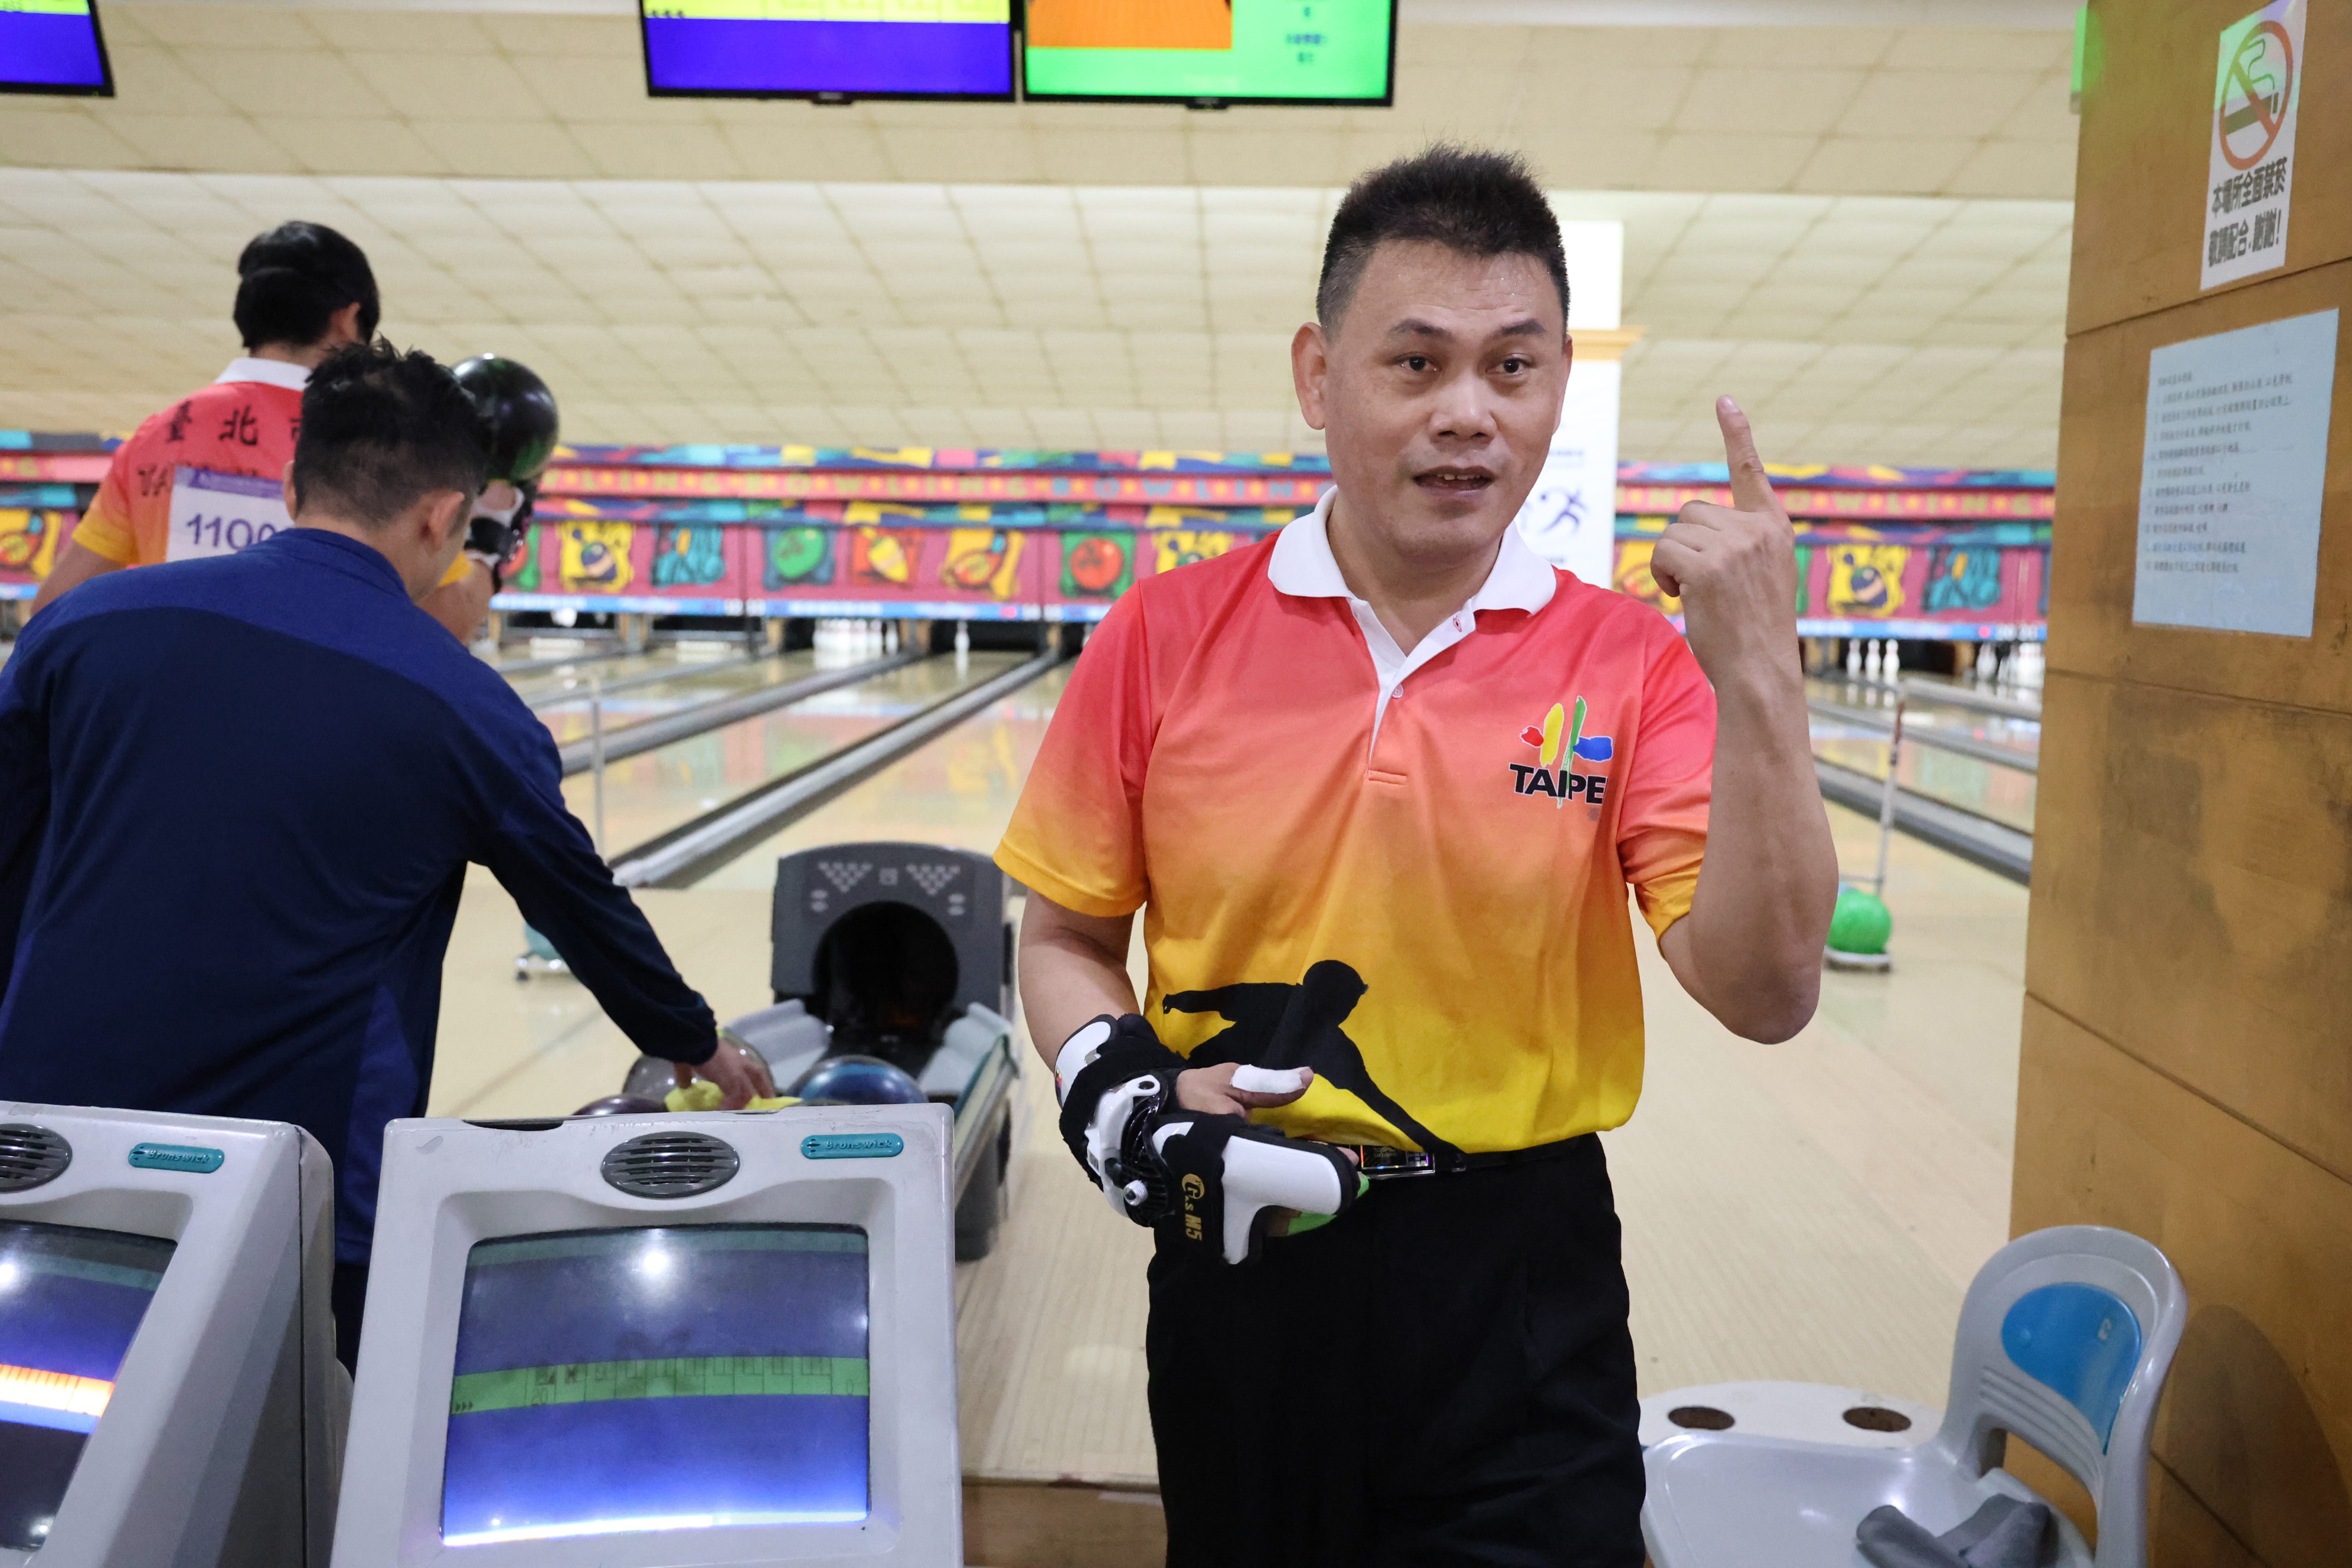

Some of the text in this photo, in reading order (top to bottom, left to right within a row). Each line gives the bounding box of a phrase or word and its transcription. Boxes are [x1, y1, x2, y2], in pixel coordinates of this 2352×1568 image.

[1508, 762, 1609, 805] TAIPE
[825, 1139, 893, 1150] Brunswick
[148, 1149, 210, 1164] Brunswick
[1185, 1213, 1202, 1241] M5
